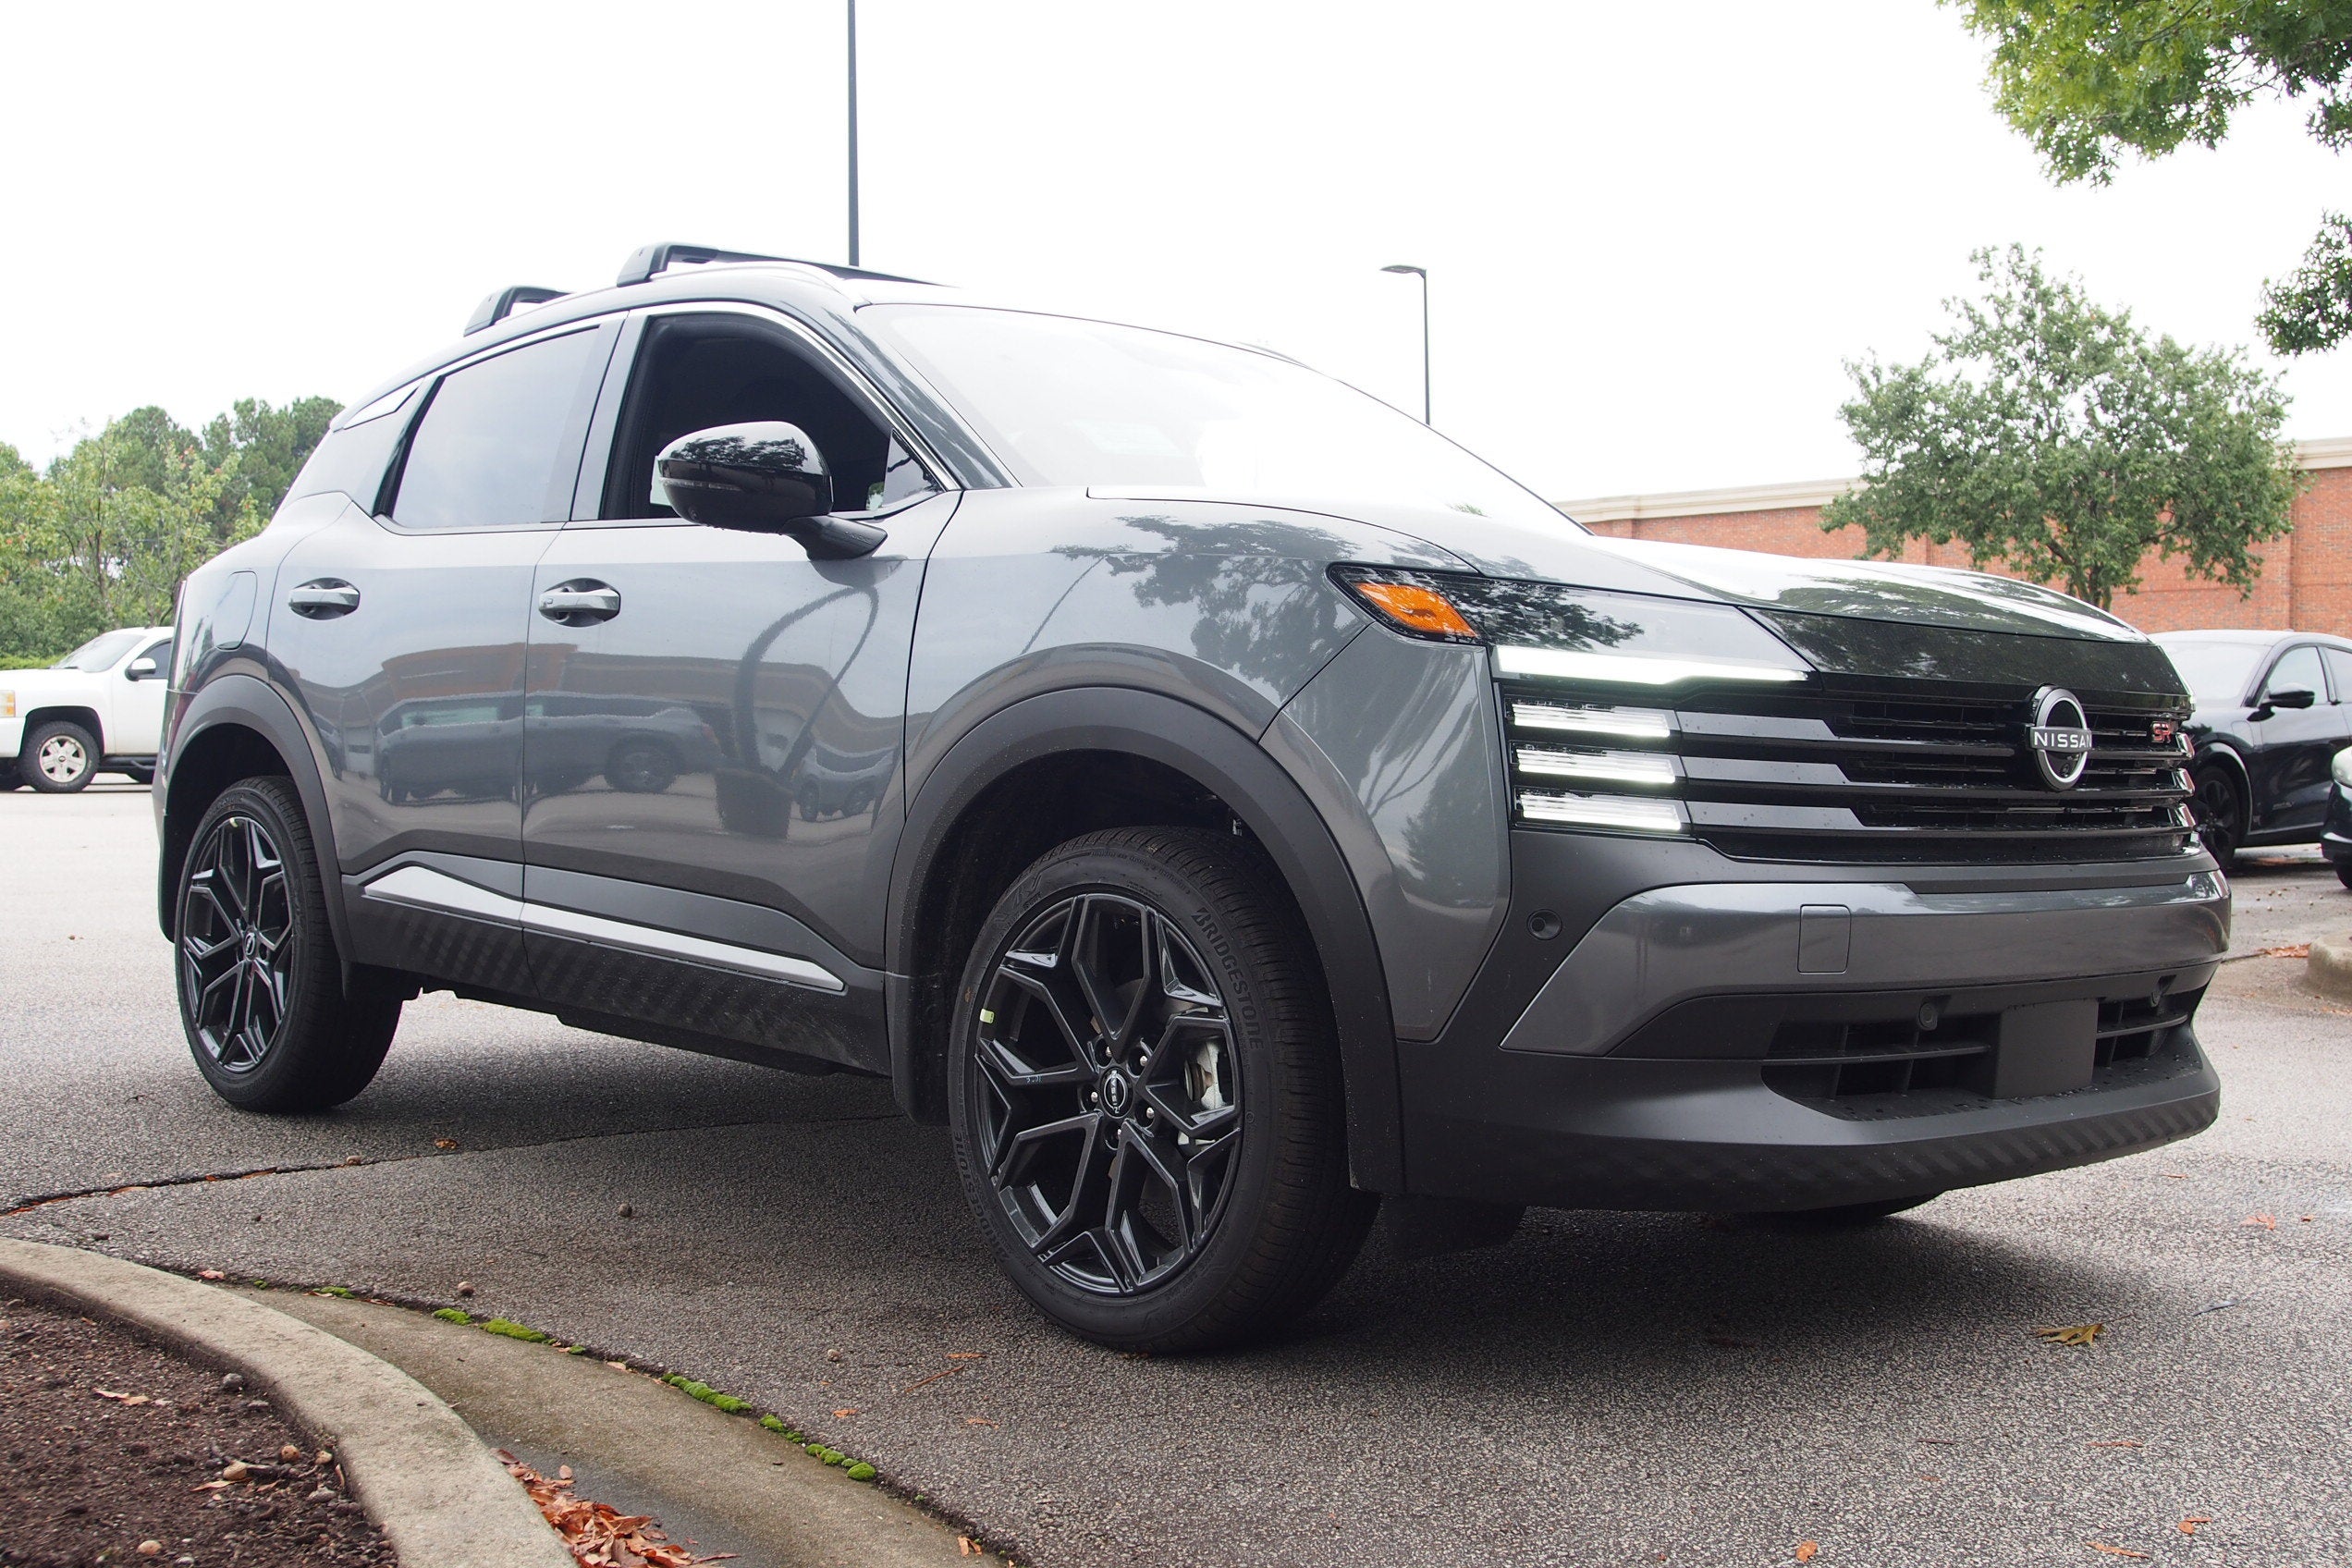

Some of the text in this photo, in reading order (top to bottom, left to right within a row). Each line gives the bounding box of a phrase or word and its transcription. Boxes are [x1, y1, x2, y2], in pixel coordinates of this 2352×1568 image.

[2034, 731, 2092, 748] NISSAN
[2152, 722, 2171, 743] SR
[1192, 908, 1264, 1049] BRIDGESTONE
[1111, 1070, 1120, 1114] NISSAN
[954, 1131, 1010, 1262] BRIDGESTONE
